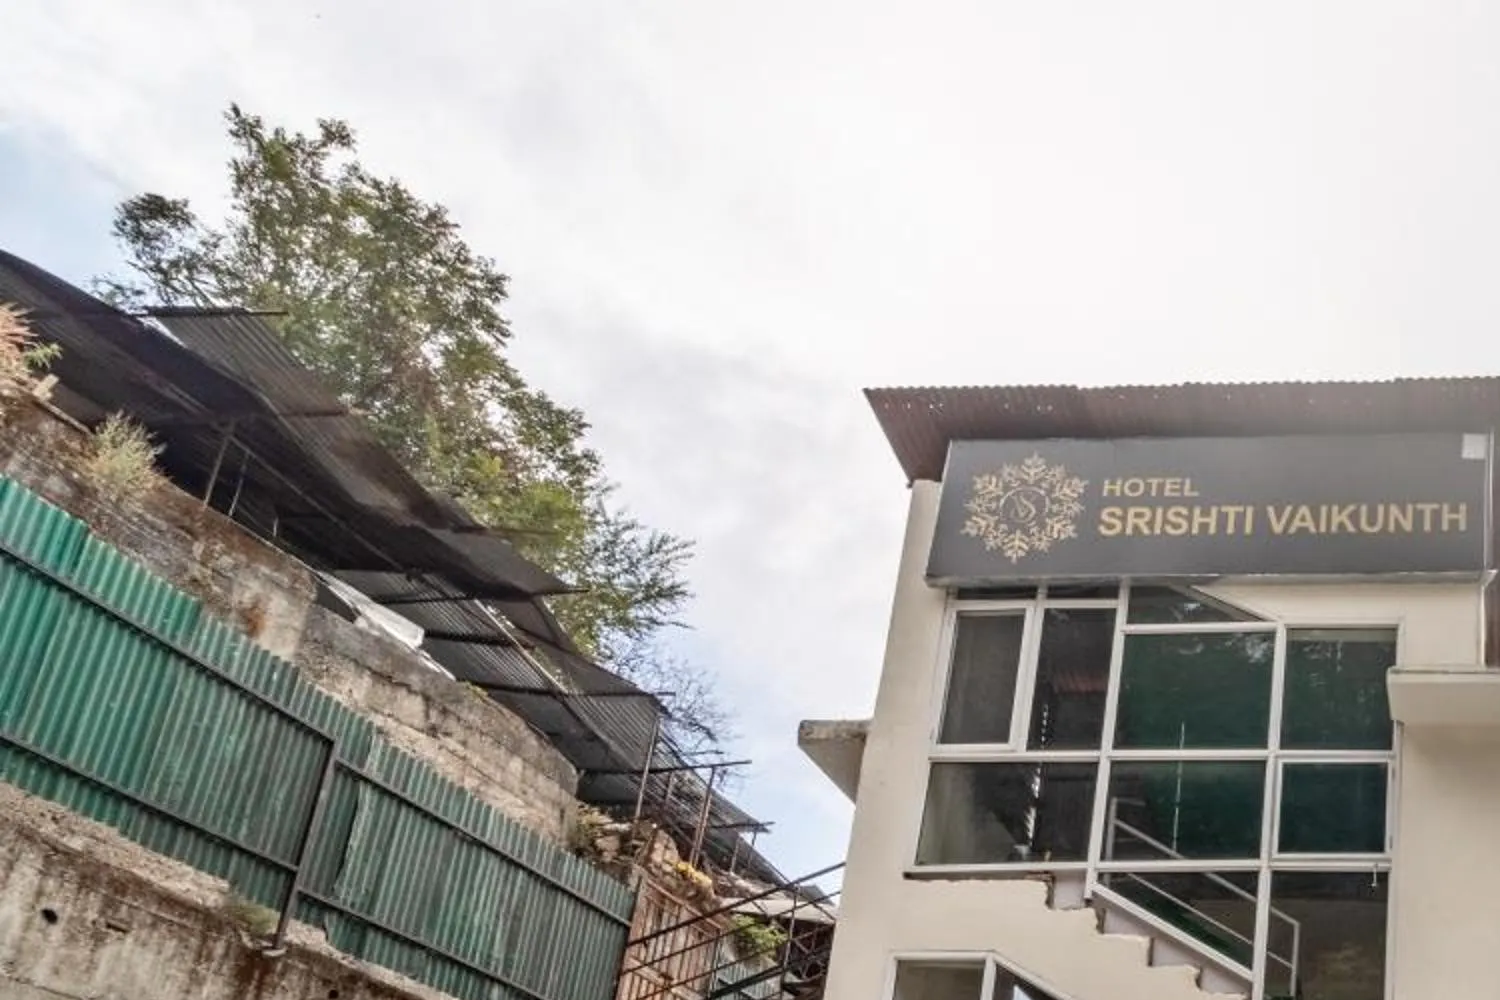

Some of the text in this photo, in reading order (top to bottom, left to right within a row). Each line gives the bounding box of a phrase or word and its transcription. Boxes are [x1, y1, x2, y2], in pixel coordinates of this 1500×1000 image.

[1101, 478, 1199, 498] HOTEL
[1098, 503, 1468, 537] SRISHTI VAIKUNTH
